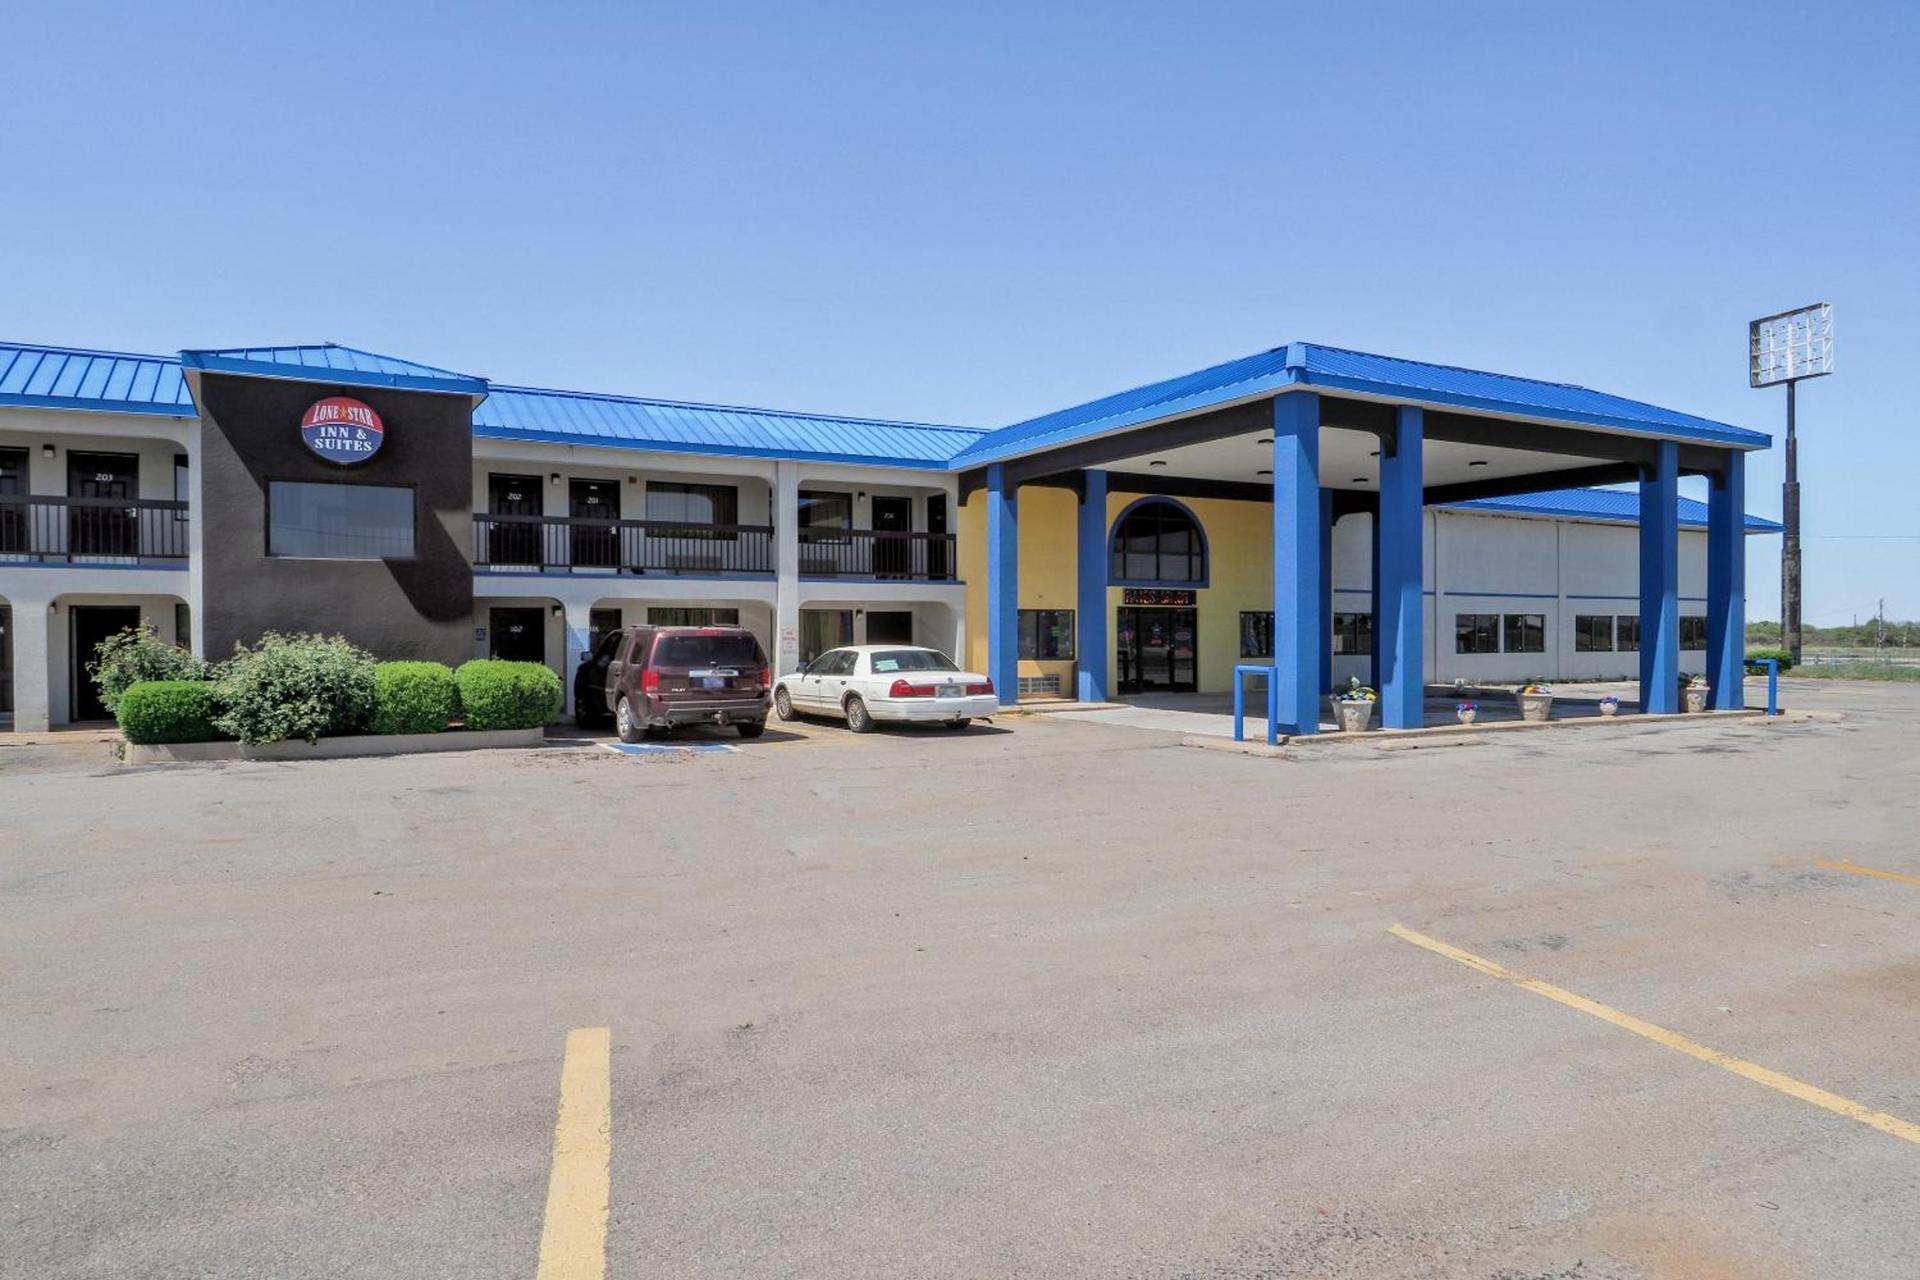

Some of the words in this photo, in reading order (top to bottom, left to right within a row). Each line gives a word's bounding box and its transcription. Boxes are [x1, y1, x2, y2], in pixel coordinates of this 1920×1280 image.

[313, 405, 339, 422] LONE
[347, 407, 374, 427] STAR
[320, 426, 349, 438] INN
[356, 428, 368, 440] &
[314, 438, 373, 451] SUITES
[95, 473, 113, 481] 203
